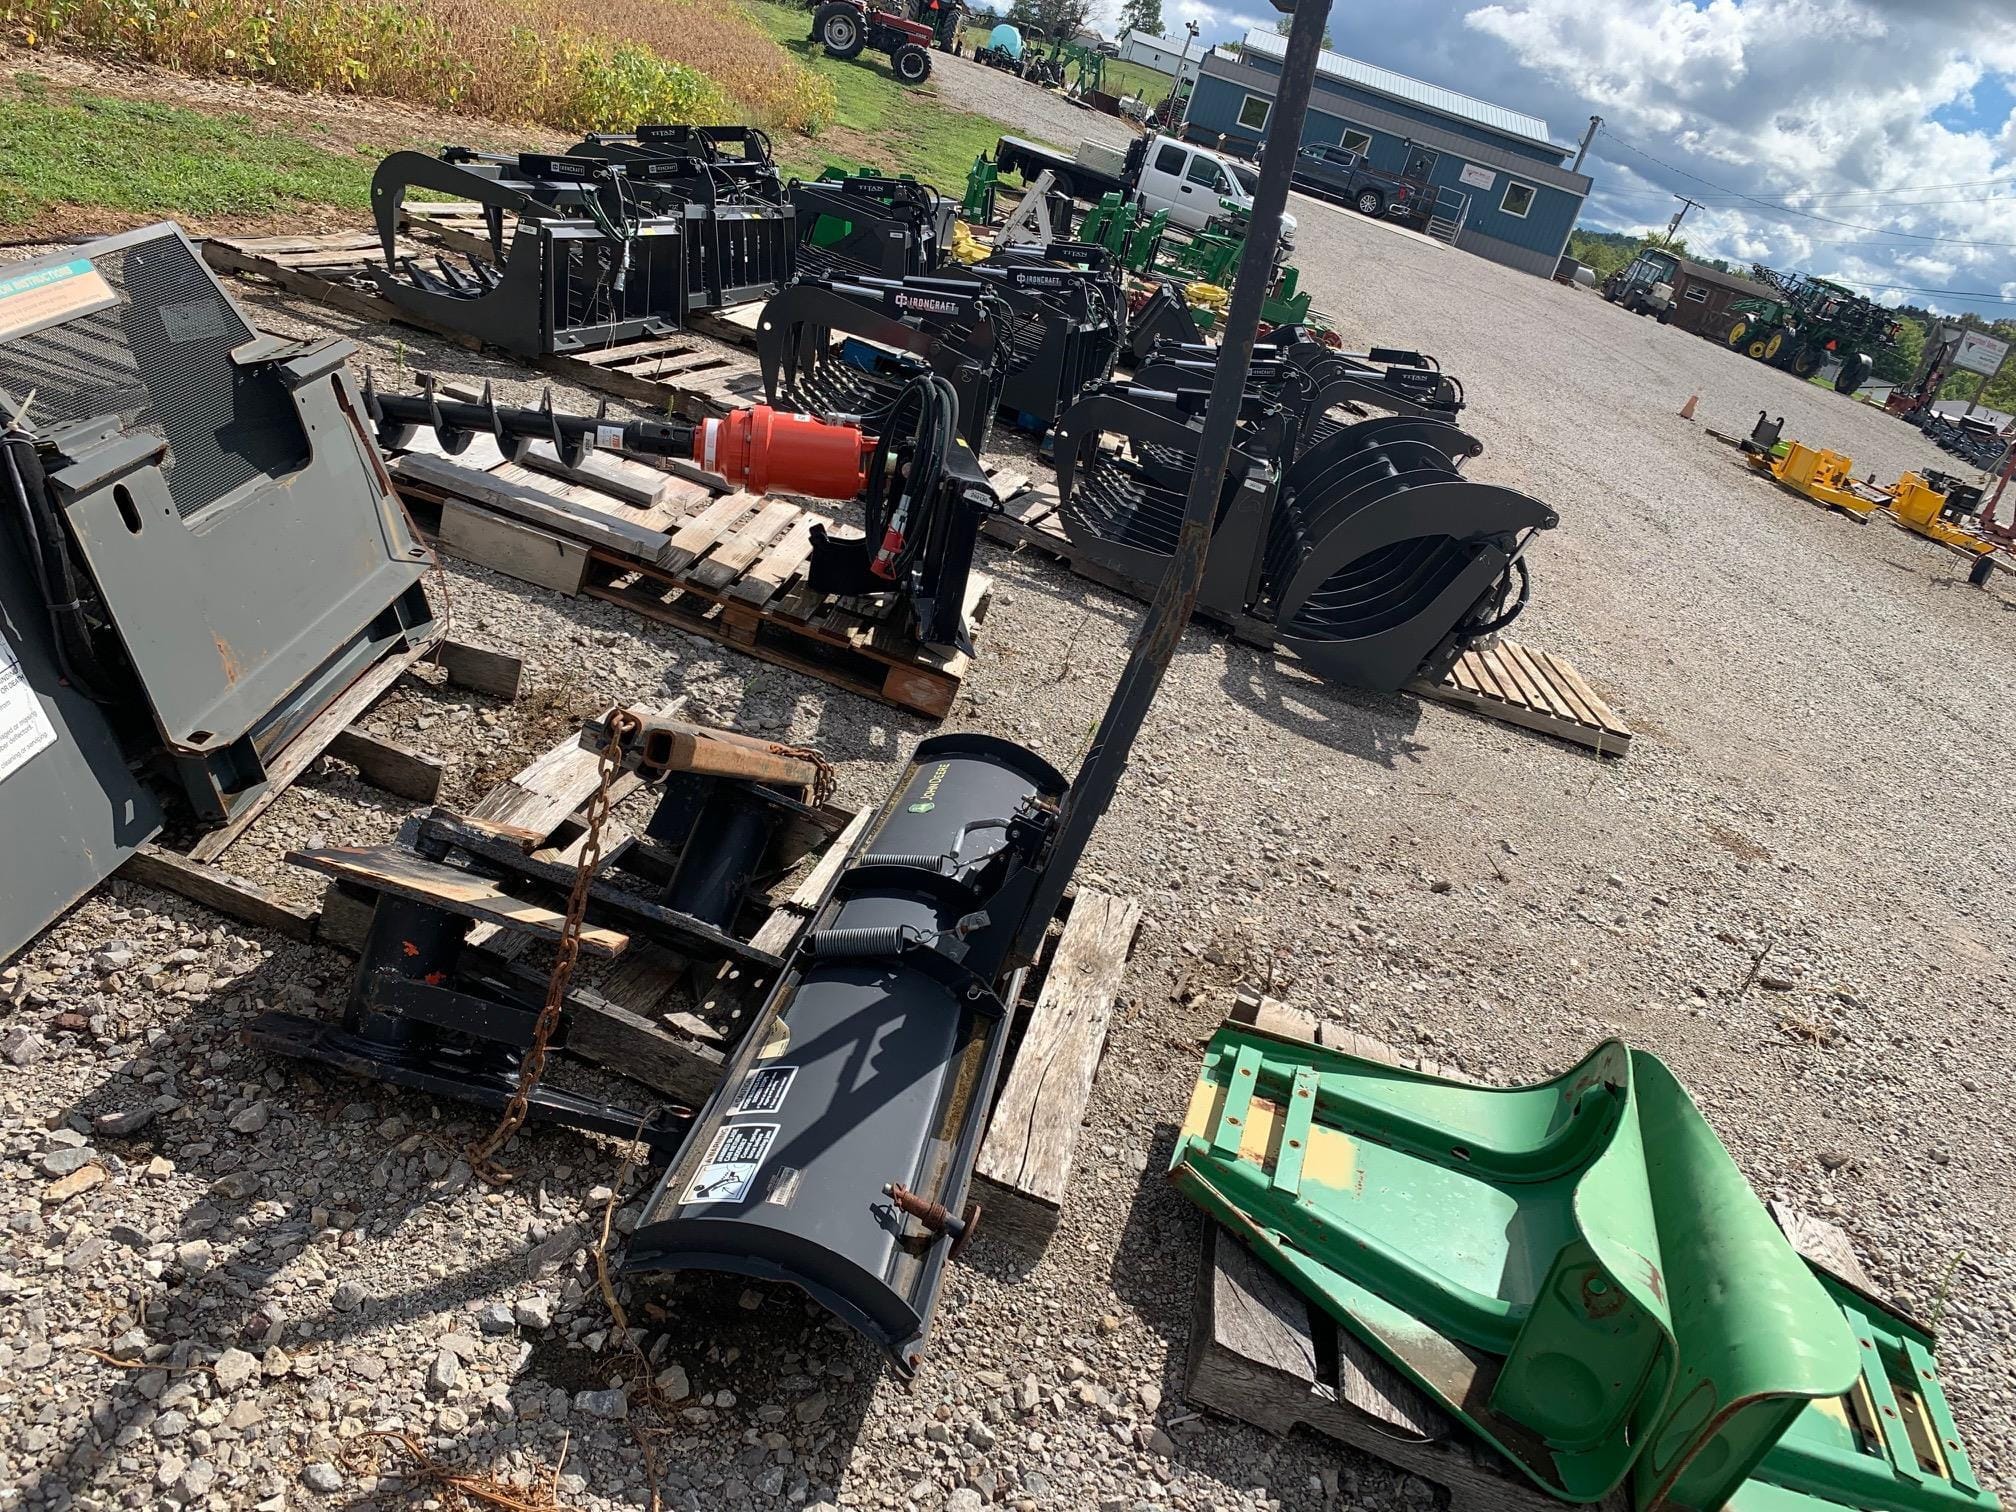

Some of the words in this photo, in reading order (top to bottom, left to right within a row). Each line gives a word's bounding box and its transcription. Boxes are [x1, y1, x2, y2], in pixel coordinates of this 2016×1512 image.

[858, 184, 884, 192] TITAN
[1062, 249, 1088, 258] TITAN
[1026, 275, 1060, 285] IRONCRAFT
[909, 297, 957, 312] IRONCRAFT
[1401, 373, 1428, 381] TITAN
